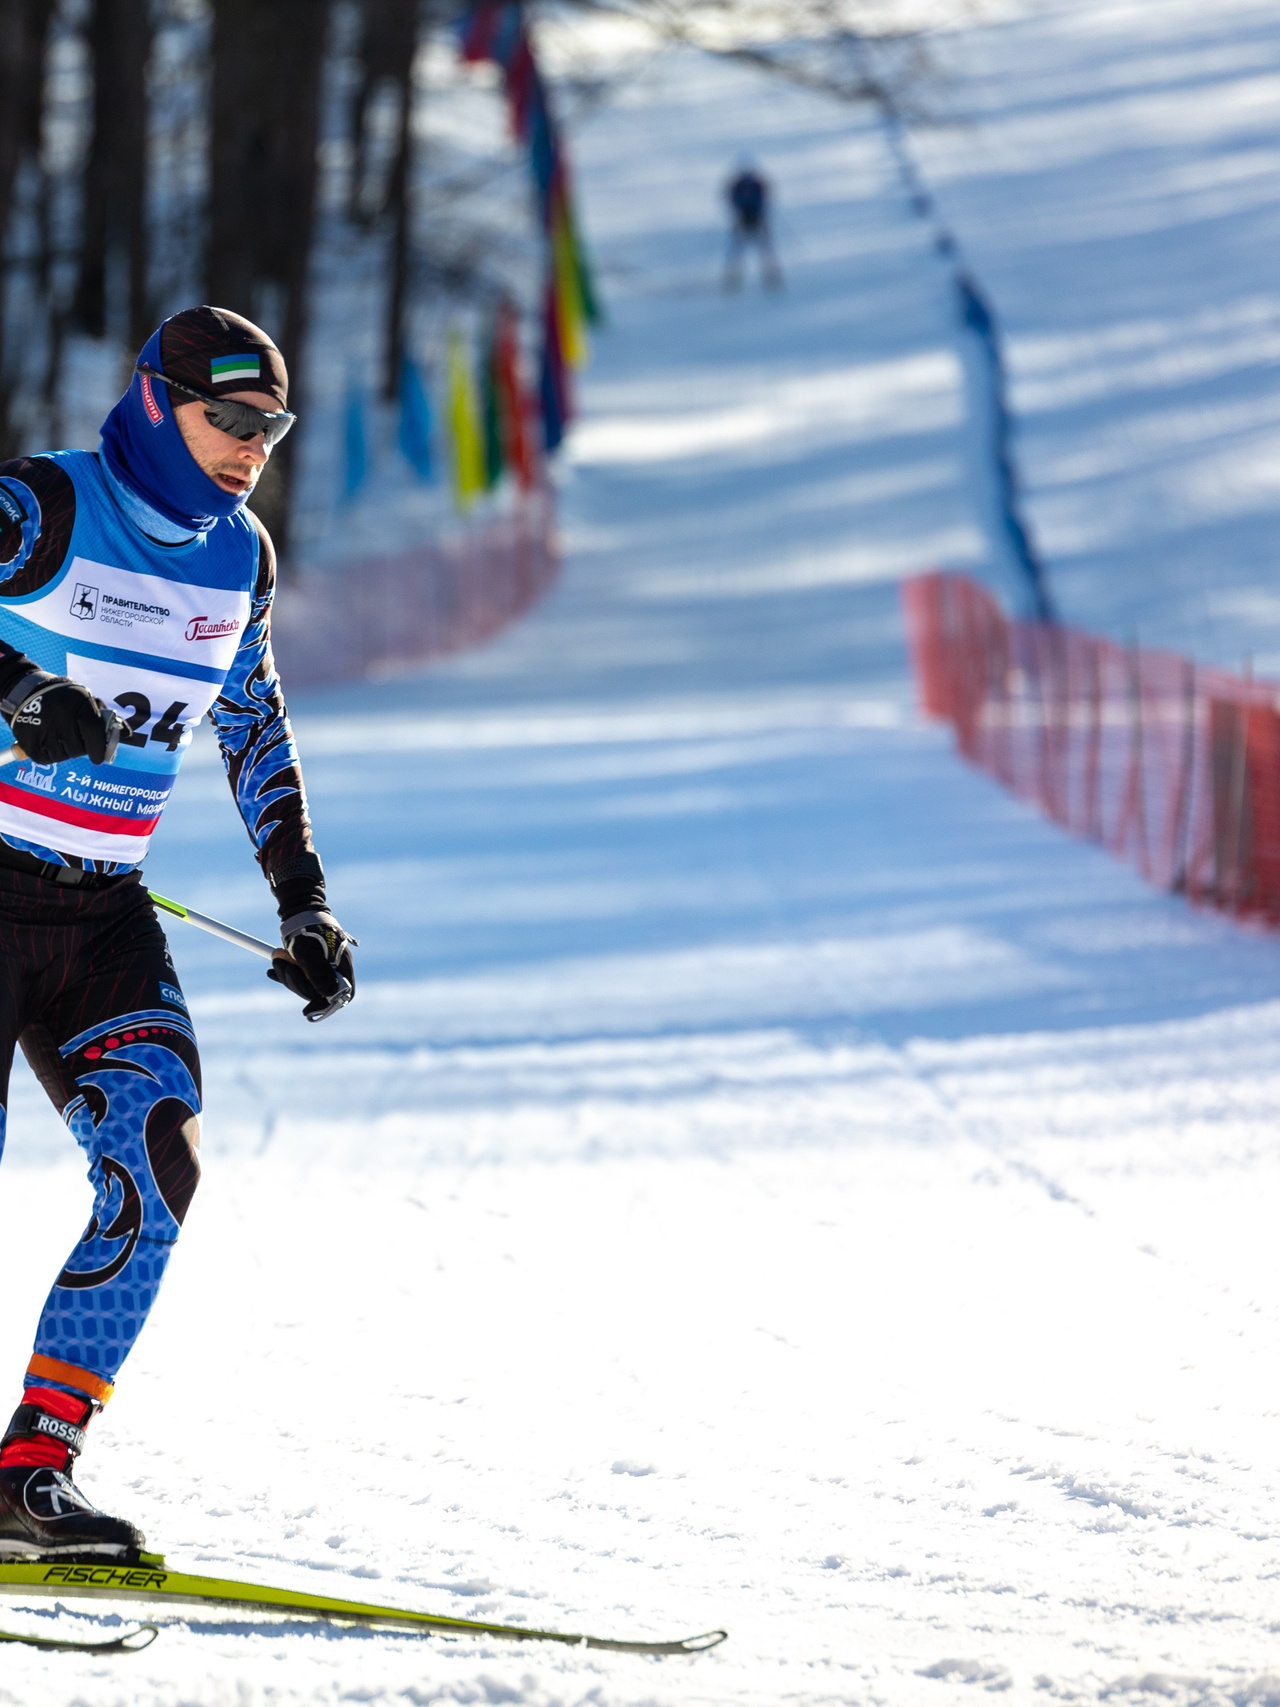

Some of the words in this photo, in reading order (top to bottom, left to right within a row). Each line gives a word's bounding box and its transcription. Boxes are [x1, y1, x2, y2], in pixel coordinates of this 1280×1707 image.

[100, 606, 164, 626] НИЖЕГОРОДСКОЙ
[102, 594, 170, 617] ПРАВИТЕЛЬСТВО
[99, 614, 133, 628] ОБЛАСТИ
[42, 1566, 168, 1589] FISCHER
